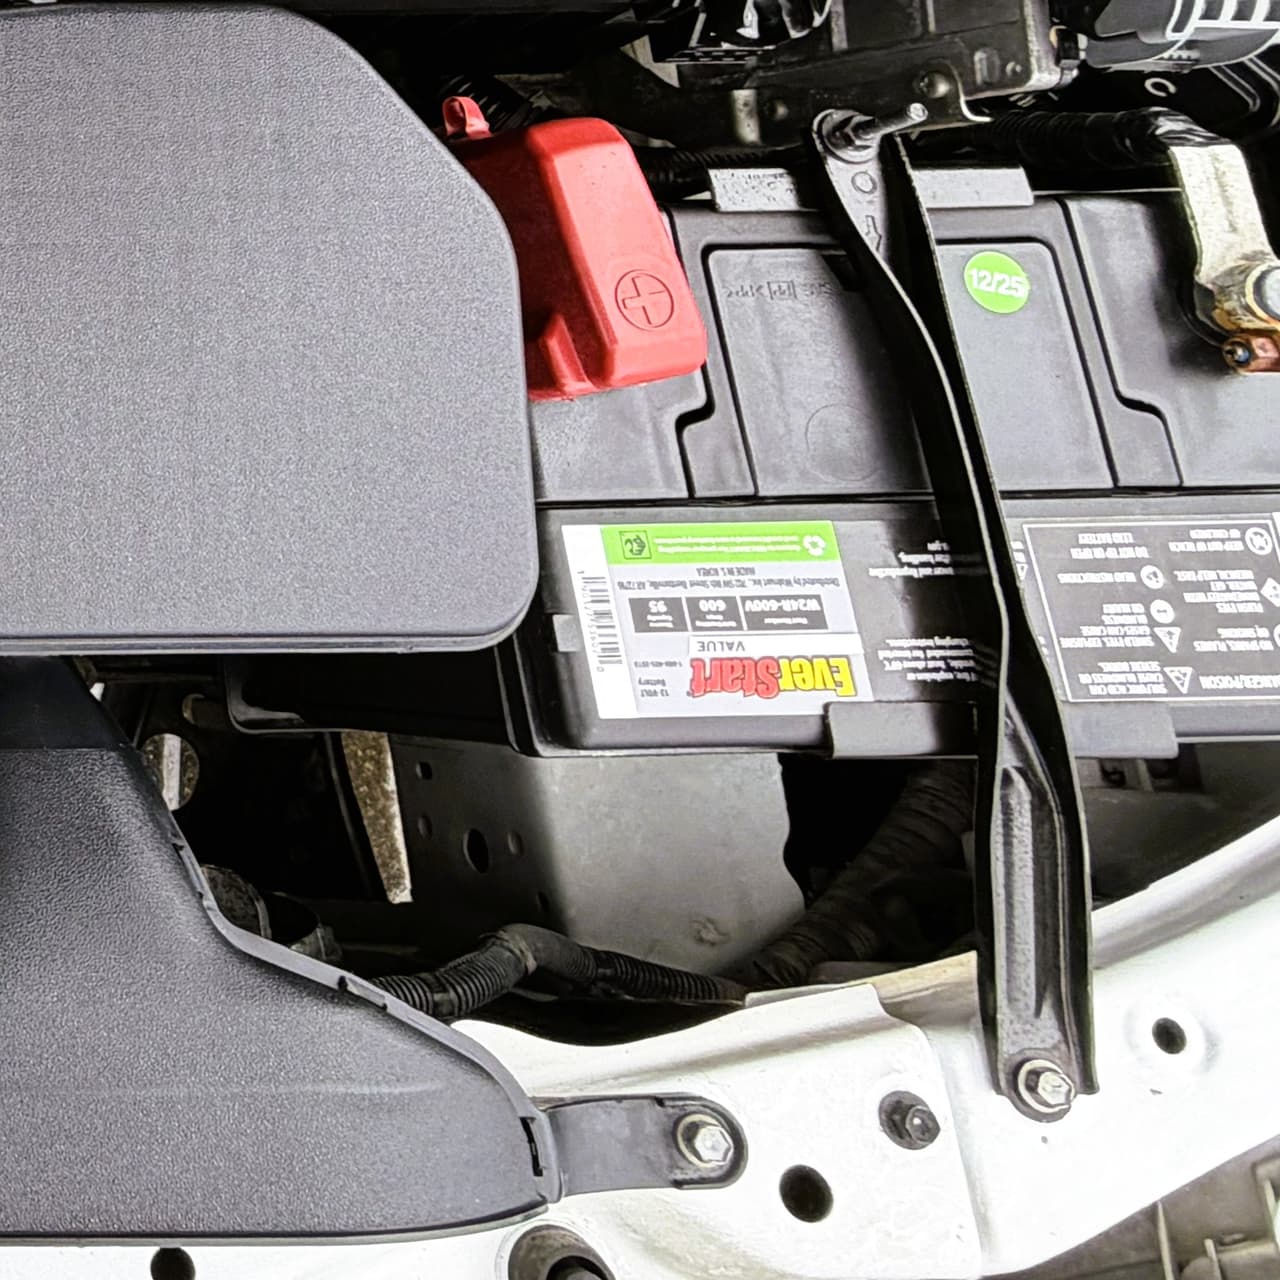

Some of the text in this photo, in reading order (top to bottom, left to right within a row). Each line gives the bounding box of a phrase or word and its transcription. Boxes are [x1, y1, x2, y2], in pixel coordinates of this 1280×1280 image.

[968, 268, 1028, 299] 12/25
[648, 600, 668, 613] 95
[698, 599, 727, 612] 600
[744, 598, 821, 612] W24R-600V
[696, 640, 745, 653] VALUE
[689, 655, 858, 700] EverStart
[1199, 675, 1280, 689] ANGER/POISON
